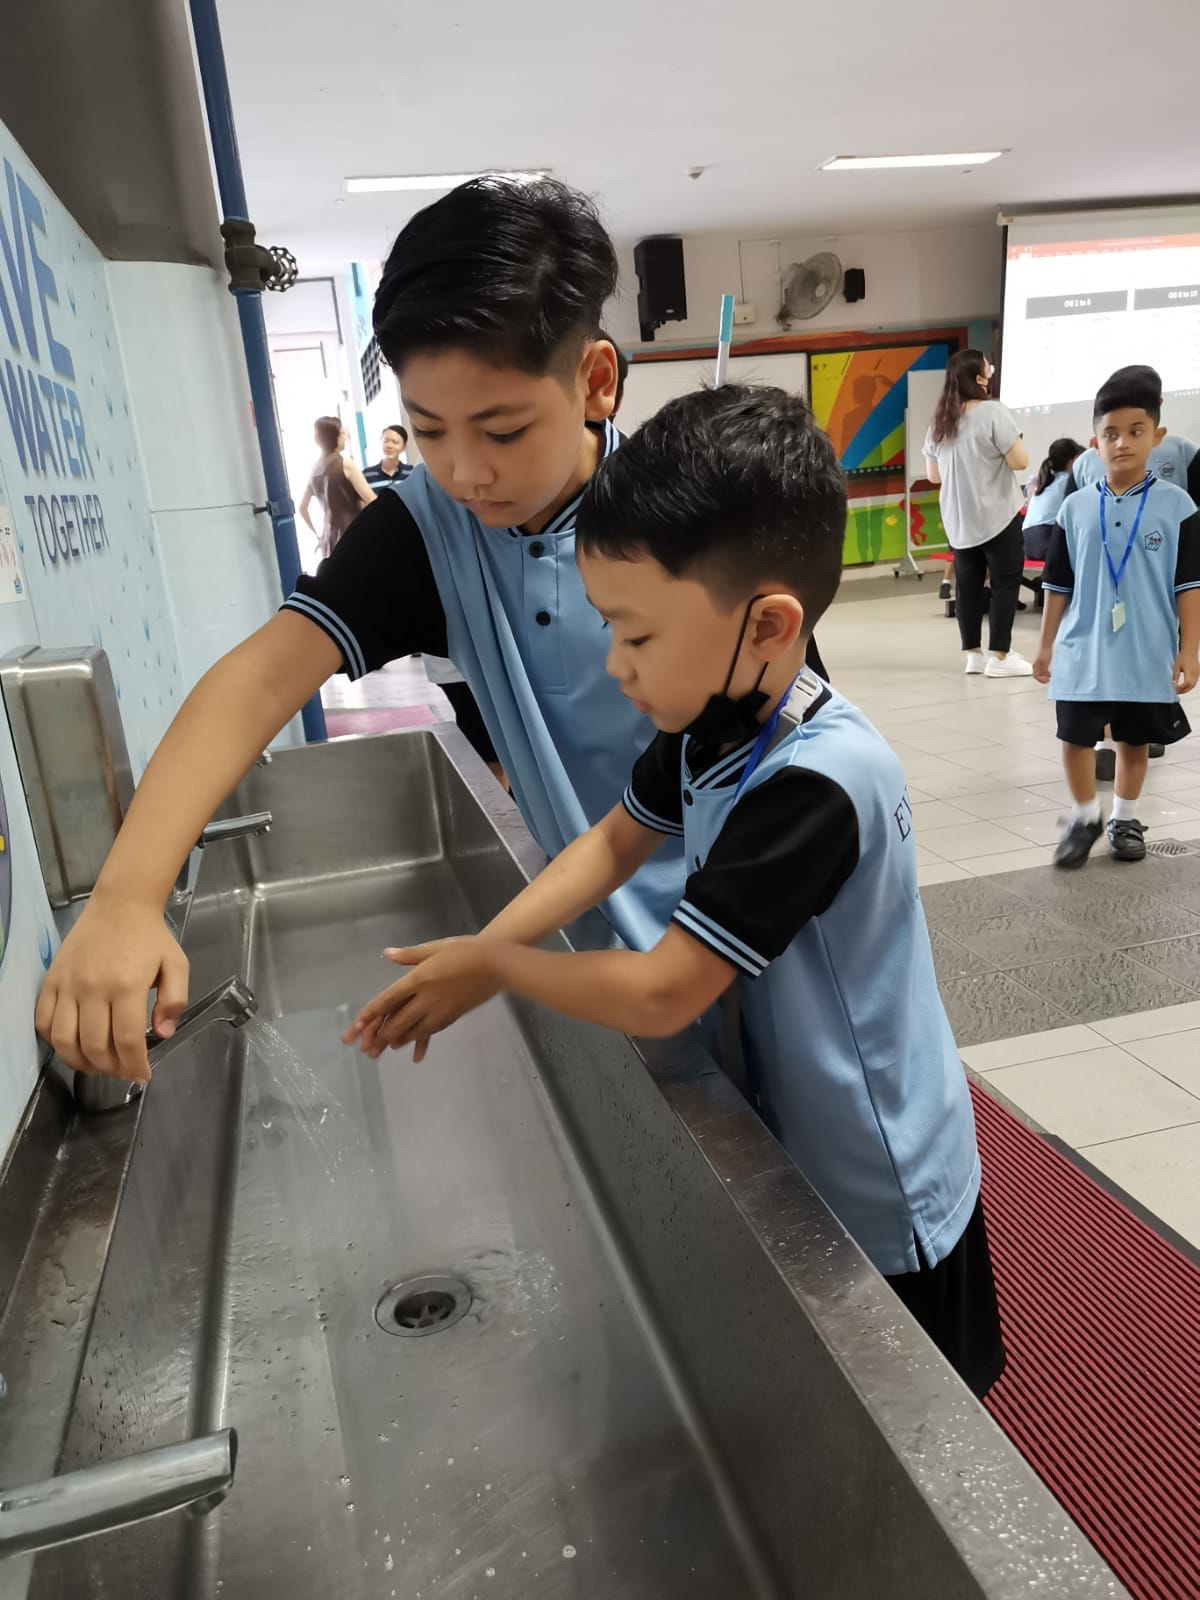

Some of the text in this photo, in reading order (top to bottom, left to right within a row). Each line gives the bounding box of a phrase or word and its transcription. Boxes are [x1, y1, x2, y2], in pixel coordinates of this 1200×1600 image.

[0, 157, 75, 377] VE
[0, 358, 95, 480] WATER
[24, 494, 110, 567] TOGETHER
